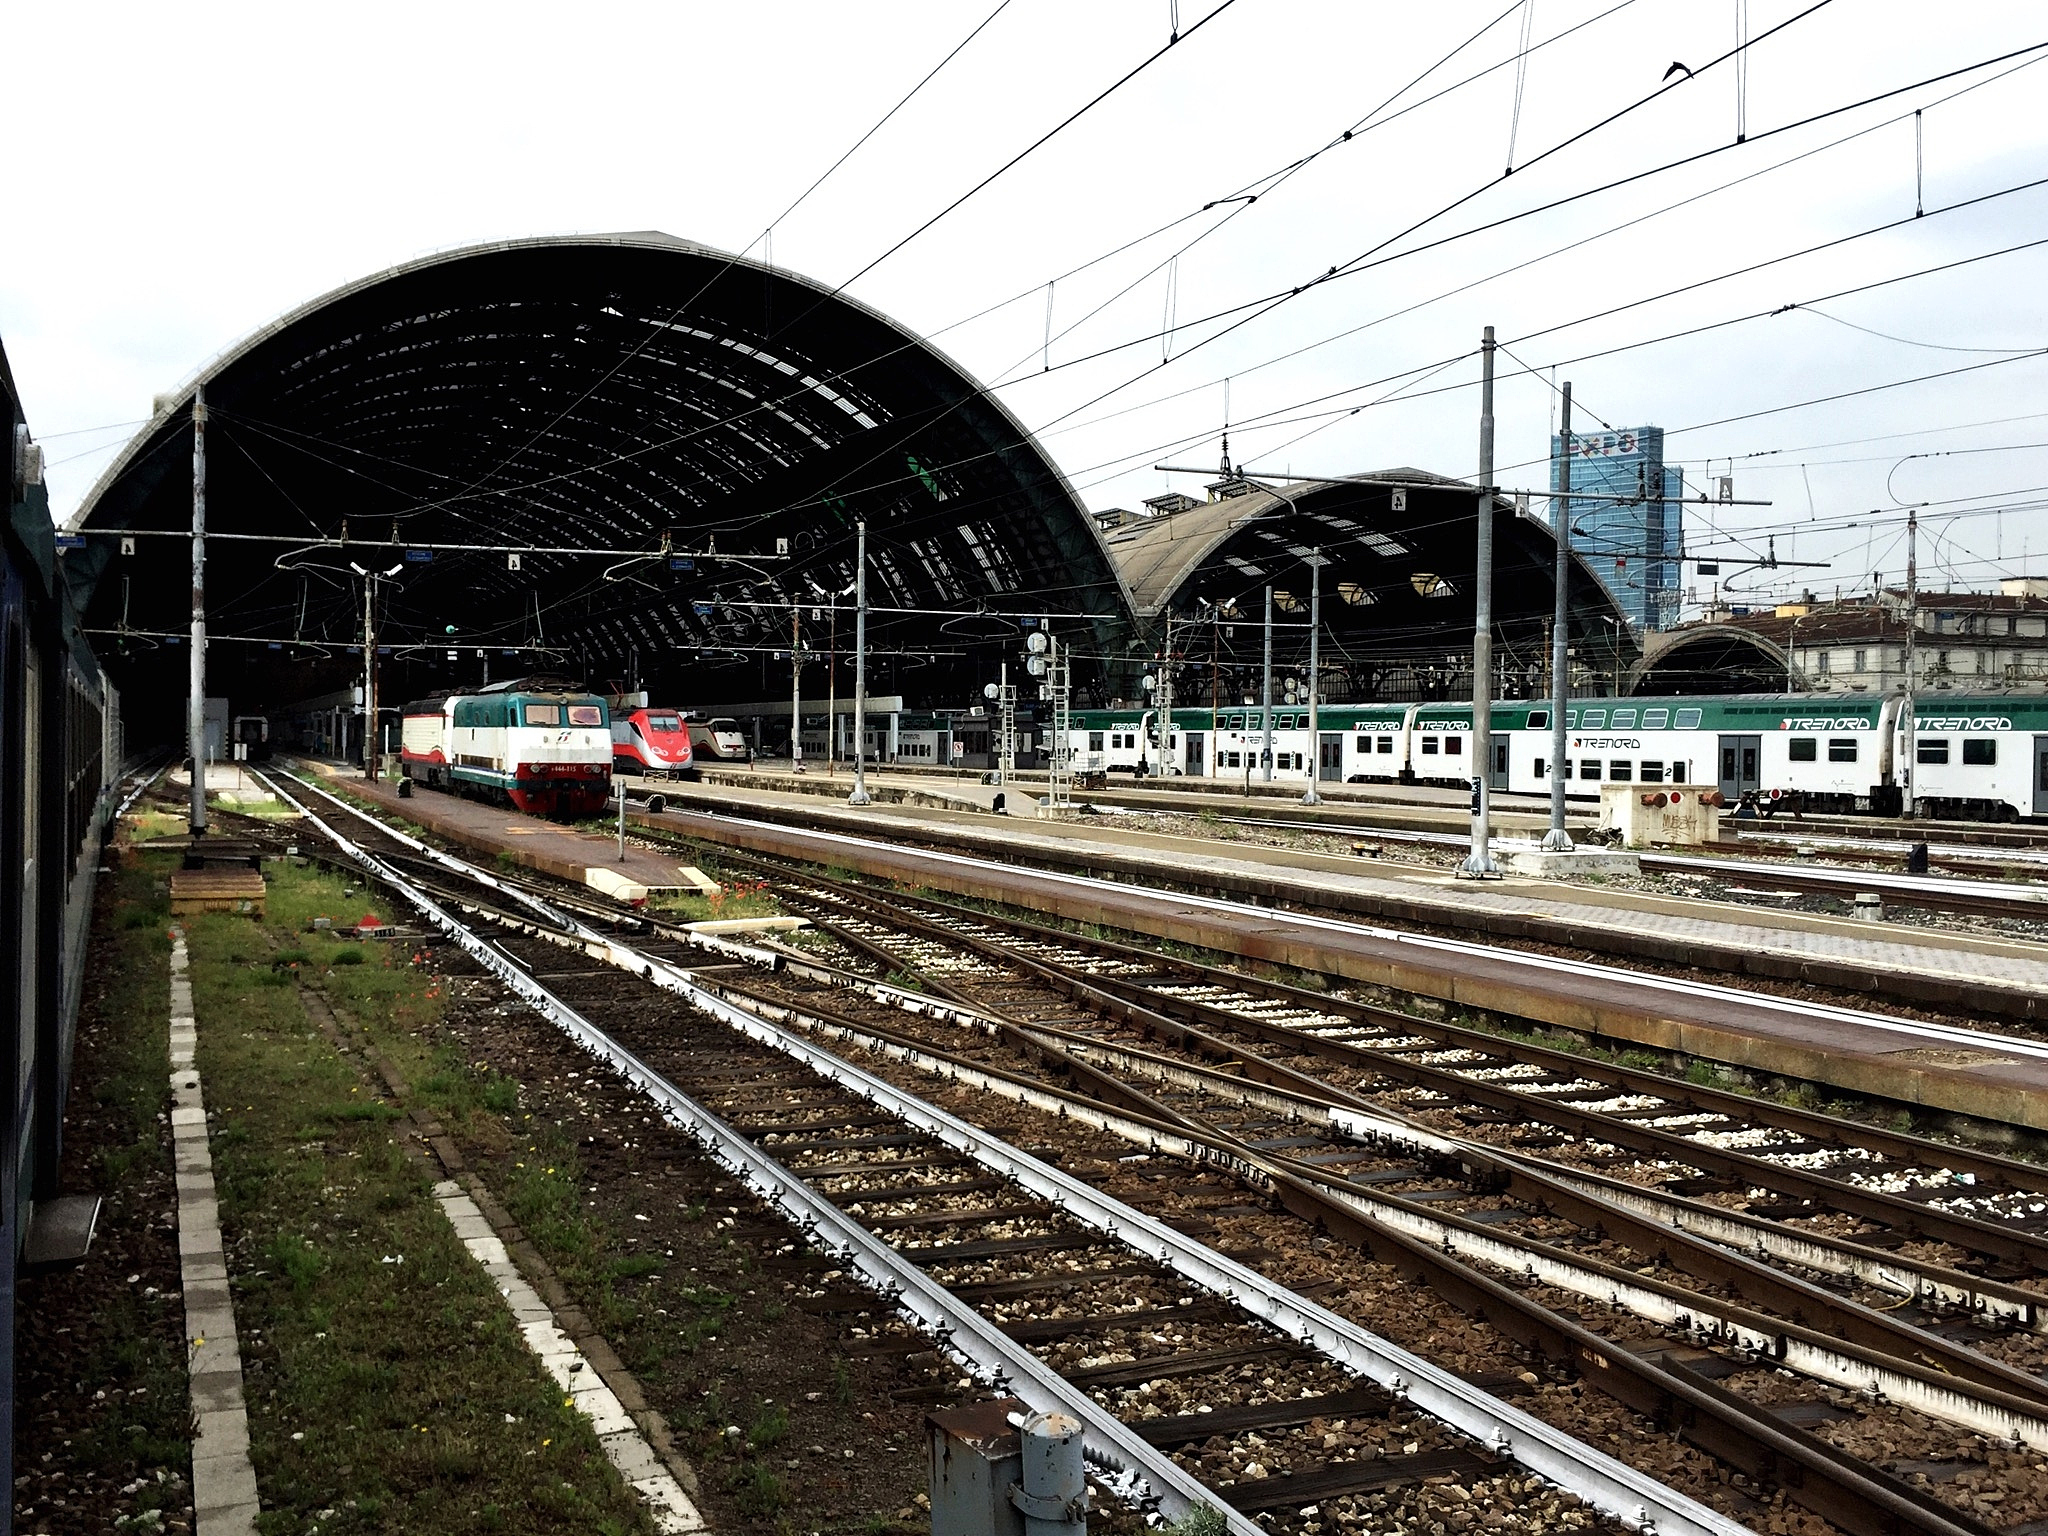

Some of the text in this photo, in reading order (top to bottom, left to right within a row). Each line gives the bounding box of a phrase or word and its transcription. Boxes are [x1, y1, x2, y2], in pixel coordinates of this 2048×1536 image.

[1569, 434, 1635, 458] EXPO
[1359, 721, 1401, 731] TRENORD
[1425, 721, 1470, 731] TRENORD
[1792, 718, 1871, 730] TRENORD
[1922, 717, 2012, 730] TRENORD
[1582, 738, 1641, 749] TRENORD
[1545, 764, 1552, 773] 2
[1664, 767, 1672, 777] 2
